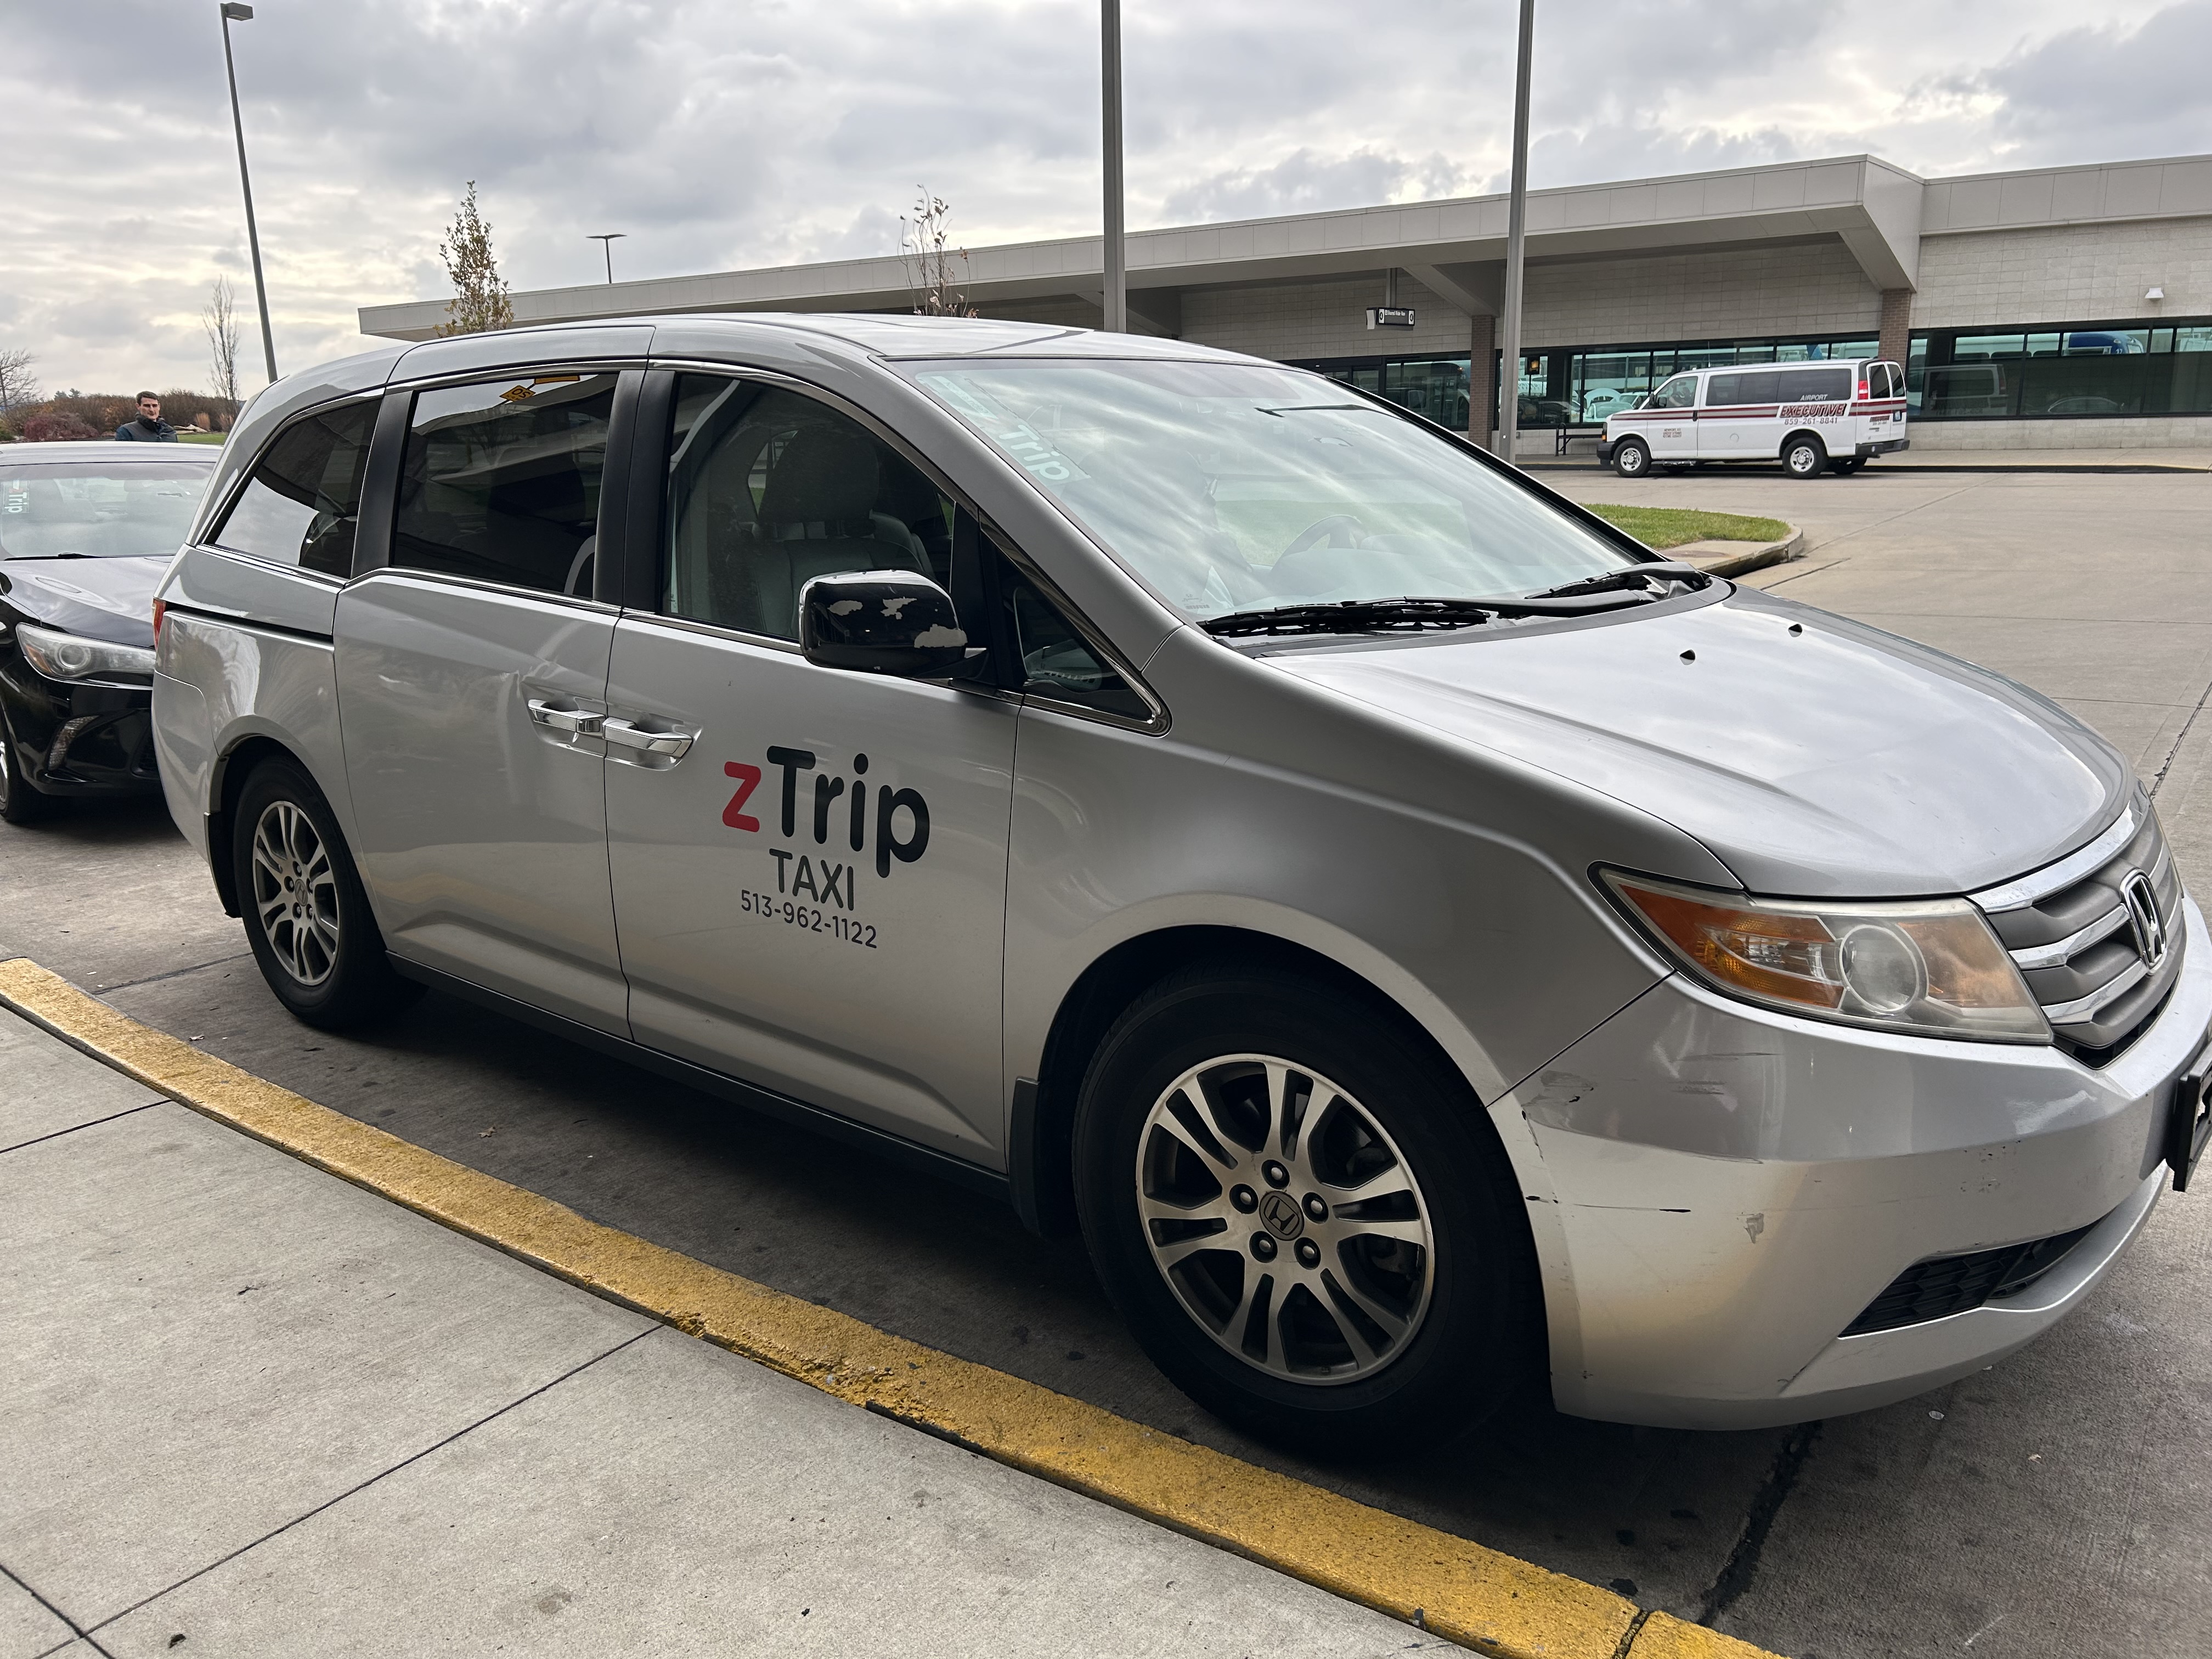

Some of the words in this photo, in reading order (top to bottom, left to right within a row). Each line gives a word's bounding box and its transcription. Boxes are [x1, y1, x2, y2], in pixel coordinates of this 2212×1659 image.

[1779, 403, 1847, 418] EXECUTIVE
[722, 745, 930, 878] zTrip
[769, 848, 854, 911] TAXI
[741, 889, 877, 949] 513-962-1122
